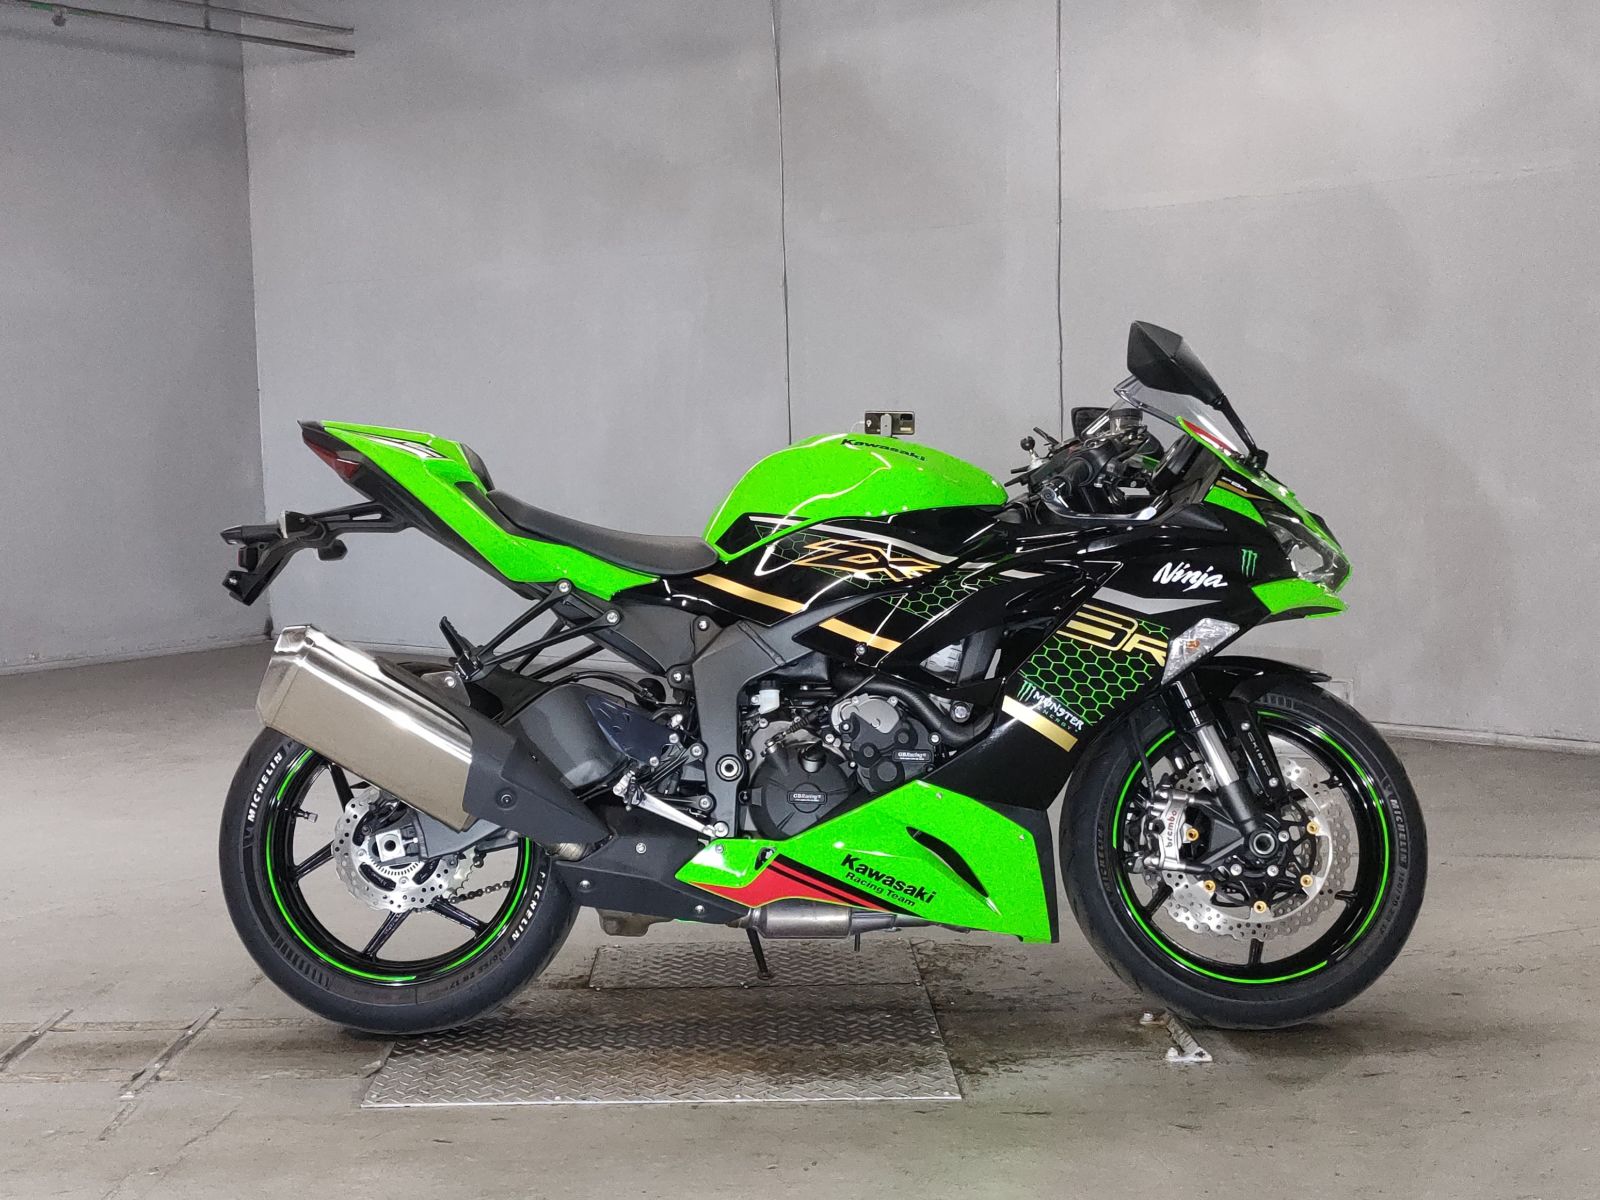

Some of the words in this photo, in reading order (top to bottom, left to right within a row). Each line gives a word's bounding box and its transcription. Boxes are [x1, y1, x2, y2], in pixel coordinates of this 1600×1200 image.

[841, 439, 925, 461] Kawasaki
[1152, 561, 1228, 592] Ninja
[247, 752, 283, 823] MICHELIN
[1165, 810, 1178, 848] brembo
[1390, 798, 1408, 863] MICHELIN
[841, 853, 937, 904] Kawasaki
[845, 871, 884, 894] Racing
[886, 889, 916, 907] Team
